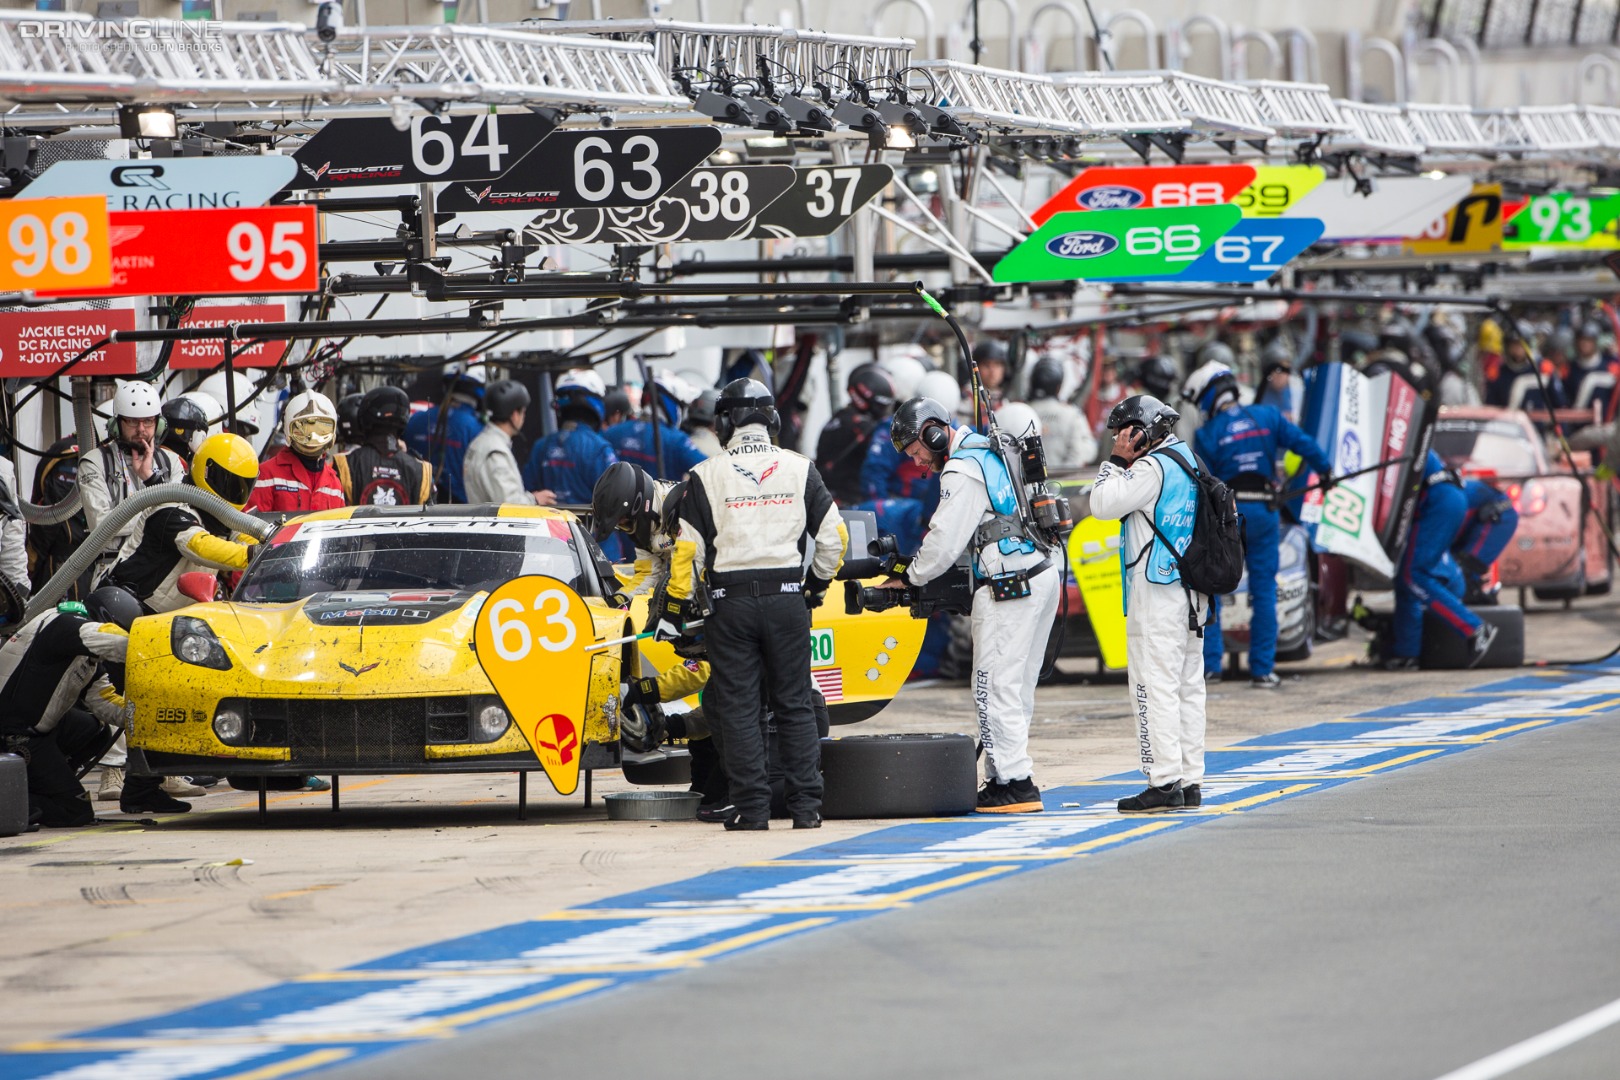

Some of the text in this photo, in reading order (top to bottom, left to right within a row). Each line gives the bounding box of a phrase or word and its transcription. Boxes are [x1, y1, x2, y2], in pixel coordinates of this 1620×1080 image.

[411, 114, 509, 176] 64
[327, 171, 401, 181] RACING
[328, 165, 404, 175] CORVETTE
[573, 135, 662, 202] 63
[123, 191, 241, 211] RACING
[489, 191, 560, 199] CORVETTE
[490, 196, 558, 206] RACING
[691, 171, 751, 222] 38
[806, 168, 862, 219] 37
[1152, 182, 1225, 208] 68
[1531, 197, 1592, 242] 93
[8, 212, 92, 277] 98
[227, 221, 307, 282] 95
[1060, 224, 1202, 256] Ford 66
[1215, 235, 1285, 263] 67
[113, 256, 154, 269] ARTIN
[19, 325, 106, 338] JACKIE CHAN
[19, 338, 92, 351] DC RACING
[725, 493, 796, 503] CORVETTE
[725, 499, 793, 509] RACING
[321, 608, 398, 620] Mobil
[488, 589, 577, 662] 63
[156, 707, 187, 724] BBS
[976, 669, 995, 750] BROADCASTER
[1137, 683, 1155, 765] BROADCASTER
